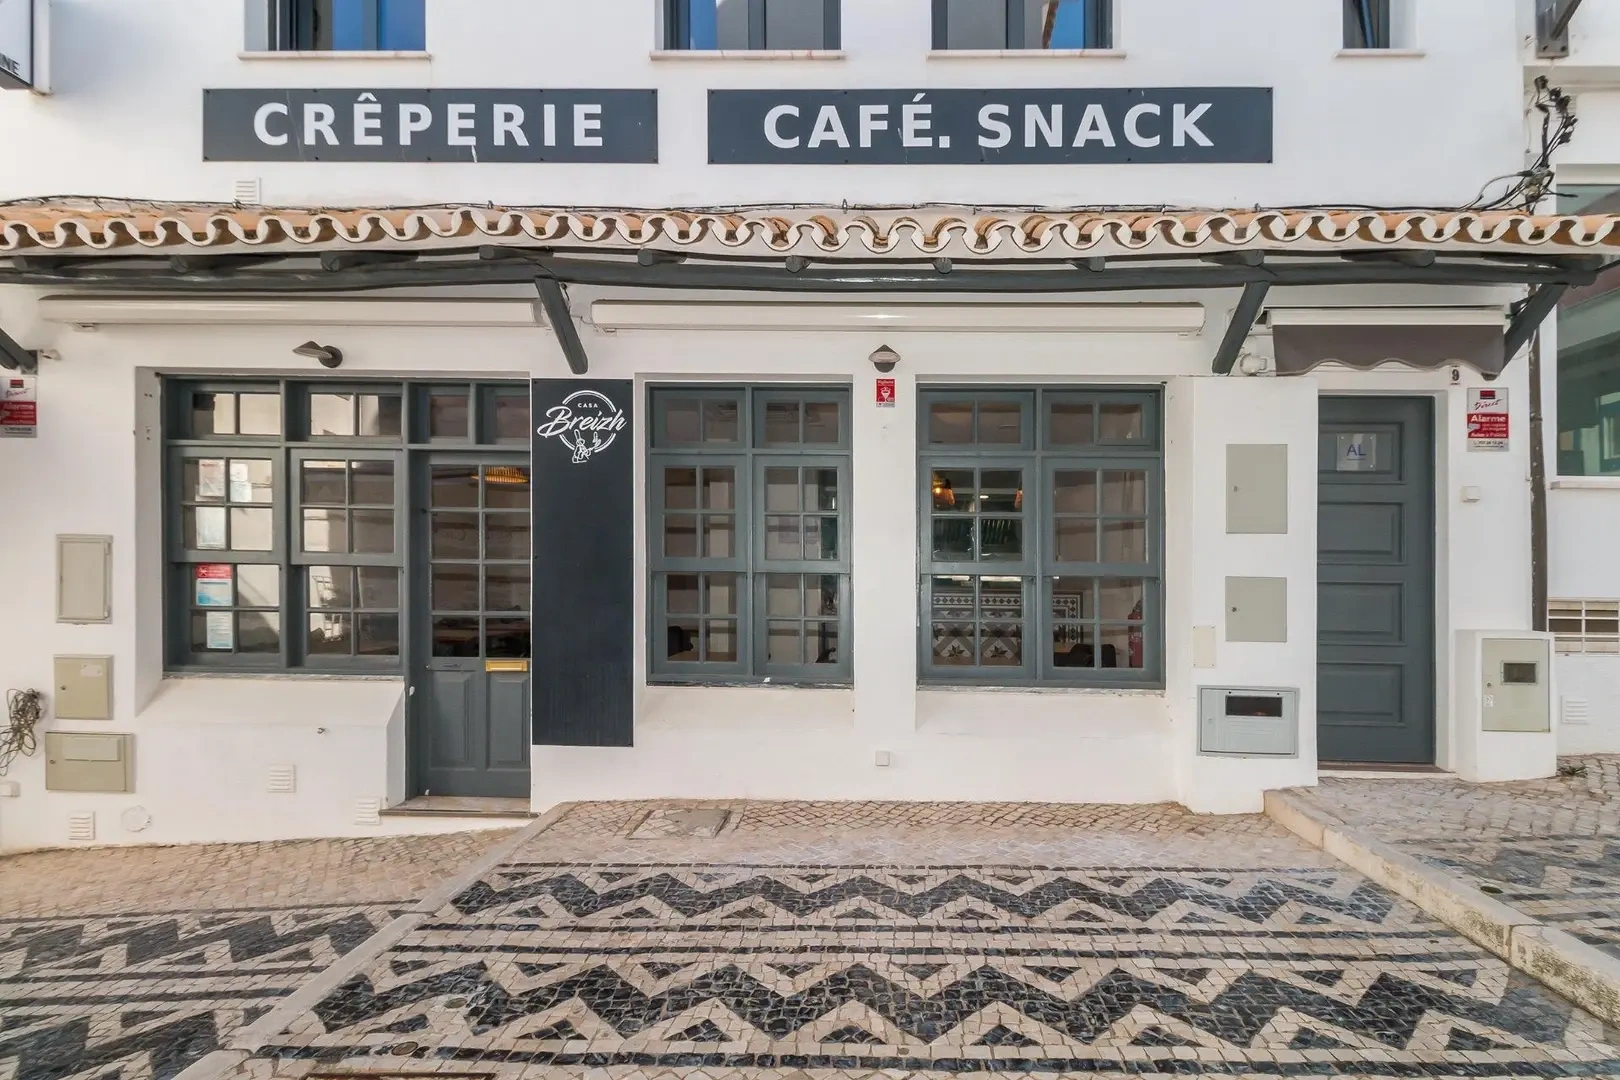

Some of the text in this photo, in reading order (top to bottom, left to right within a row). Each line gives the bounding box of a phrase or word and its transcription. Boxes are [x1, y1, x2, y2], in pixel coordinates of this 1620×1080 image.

[253, 92, 603, 147] CRÊPERIE
[763, 93, 1214, 148] CAFÉ. SNACK
[1451, 368, 1460, 381] 9
[537, 406, 627, 438] Breizh
[1470, 414, 1506, 423] Alarme
[1346, 443, 1367, 457] AL
